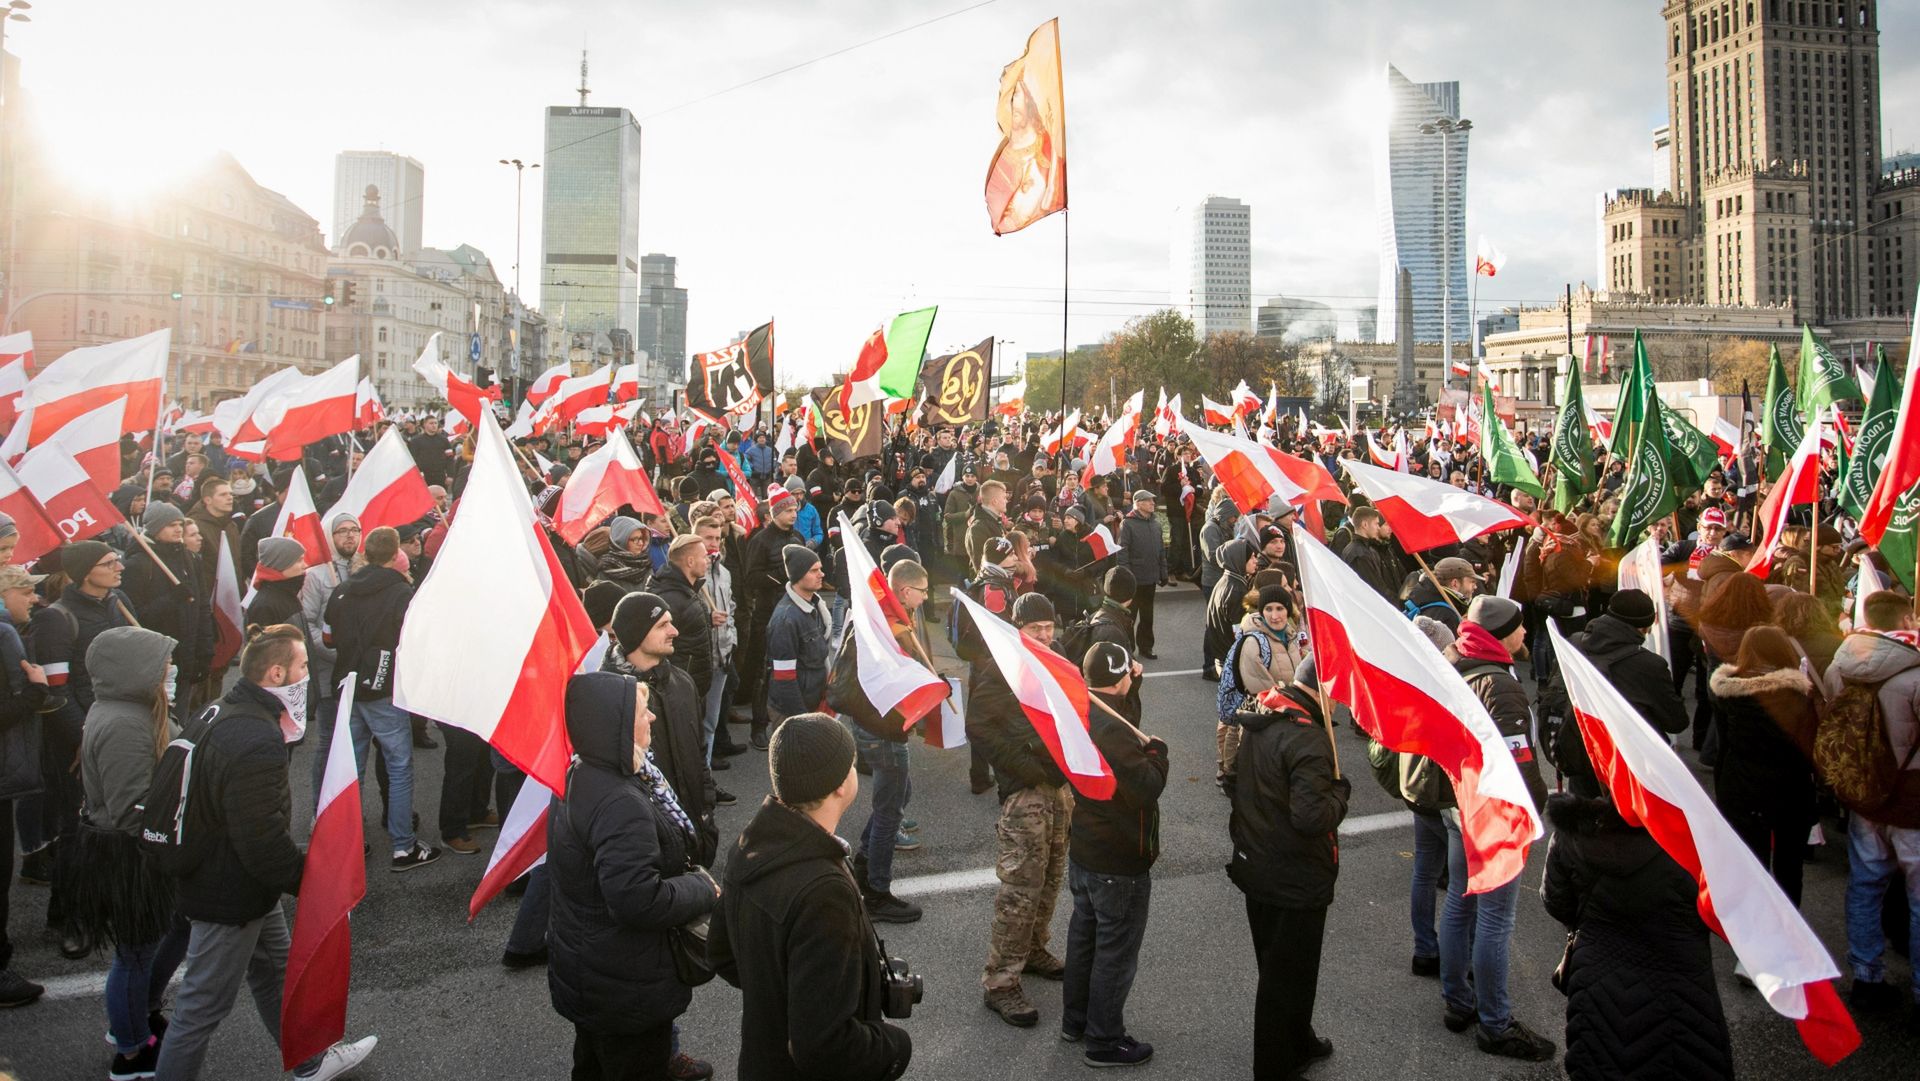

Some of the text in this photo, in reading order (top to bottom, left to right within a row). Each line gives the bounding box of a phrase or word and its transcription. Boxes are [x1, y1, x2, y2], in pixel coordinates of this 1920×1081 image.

[1852, 461, 1870, 502] STRANA
[376, 654, 390, 688] adidas
[143, 828, 168, 844] Reebok
